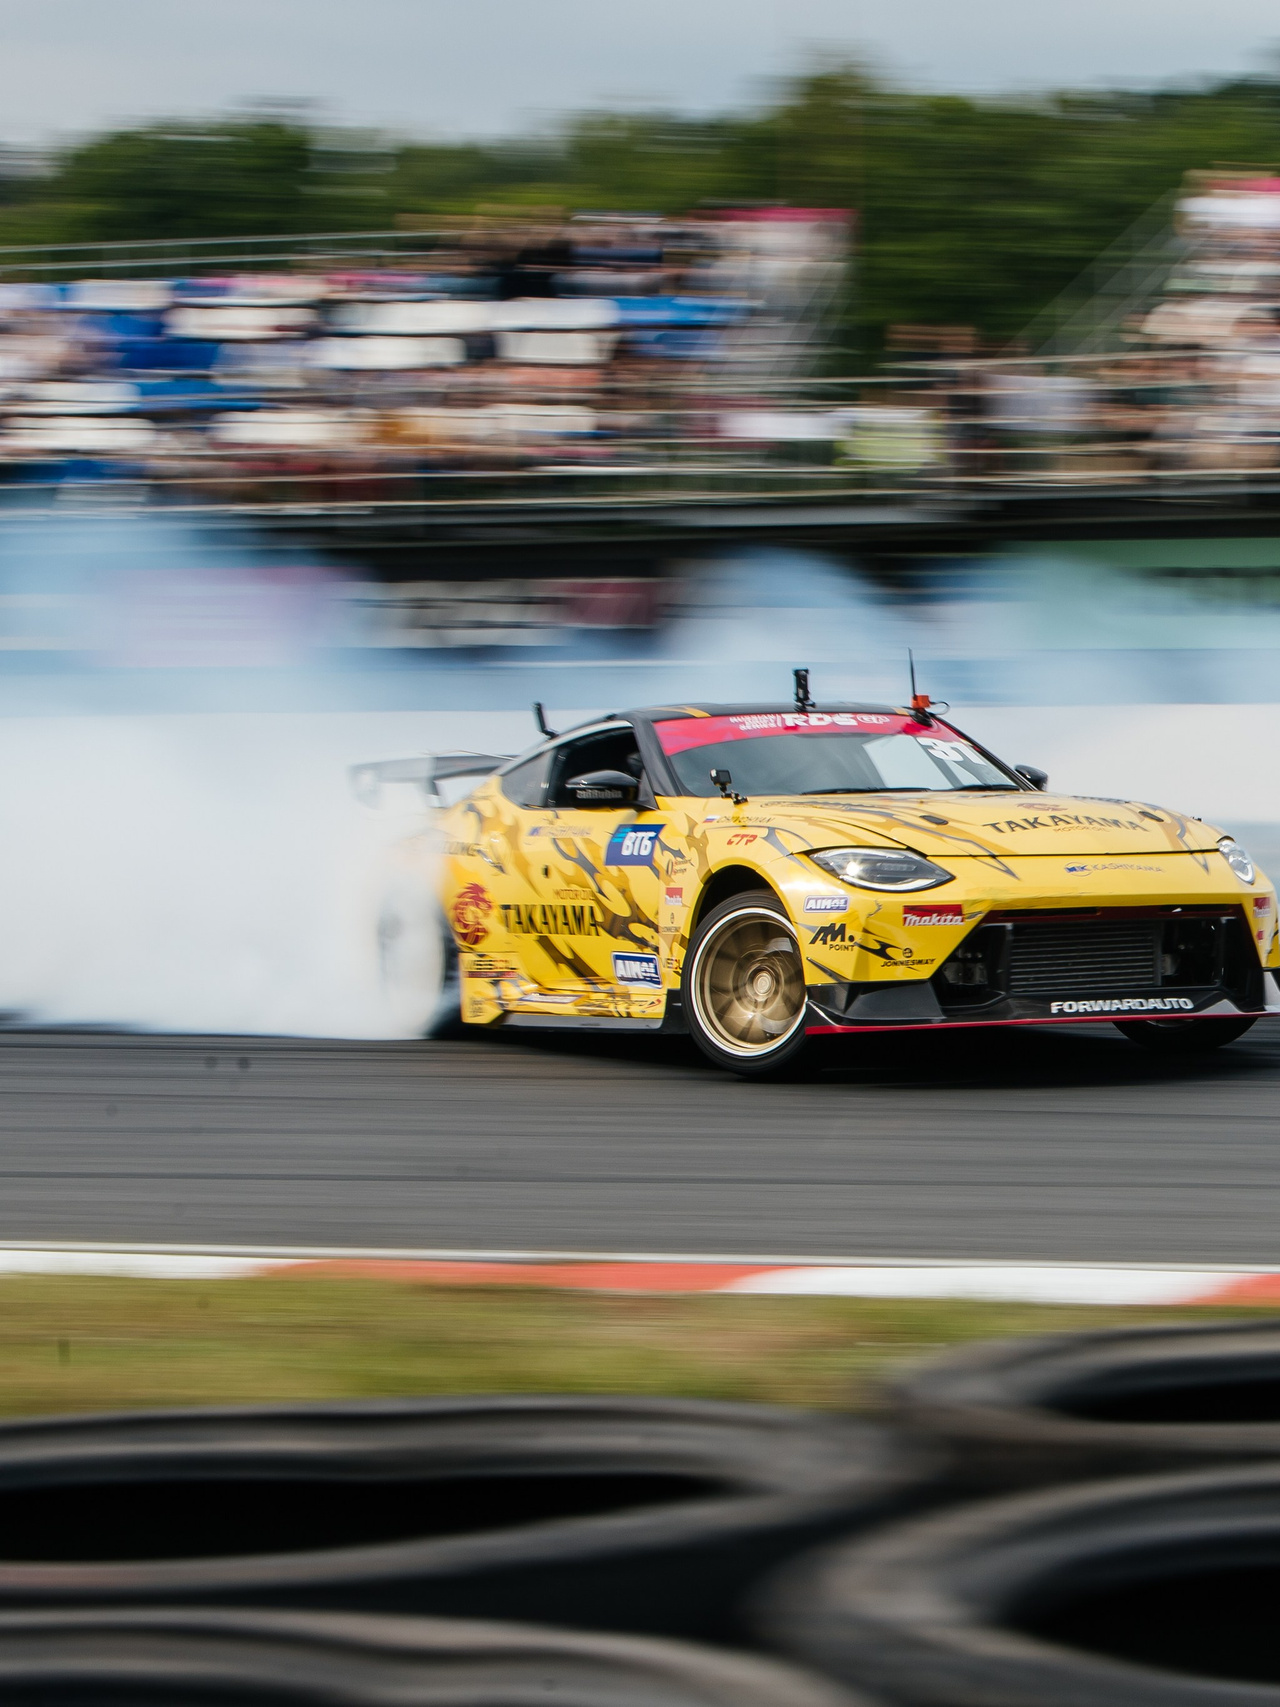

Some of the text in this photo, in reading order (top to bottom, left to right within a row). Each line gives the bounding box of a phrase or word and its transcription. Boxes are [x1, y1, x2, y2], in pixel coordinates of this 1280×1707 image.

[780, 713, 858, 727] RDS
[915, 736, 988, 766] 31
[982, 813, 1150, 834] TAKAYAMA
[620, 832, 657, 857] ВТБ
[1092, 862, 1166, 874] KASHIYAMA
[500, 903, 599, 937] TAKAYAMA
[902, 912, 965, 927] Makita
[828, 943, 855, 952] POINT
[880, 957, 936, 968] JONNESWAY
[1050, 997, 1195, 1014] FORWARDAUTO
